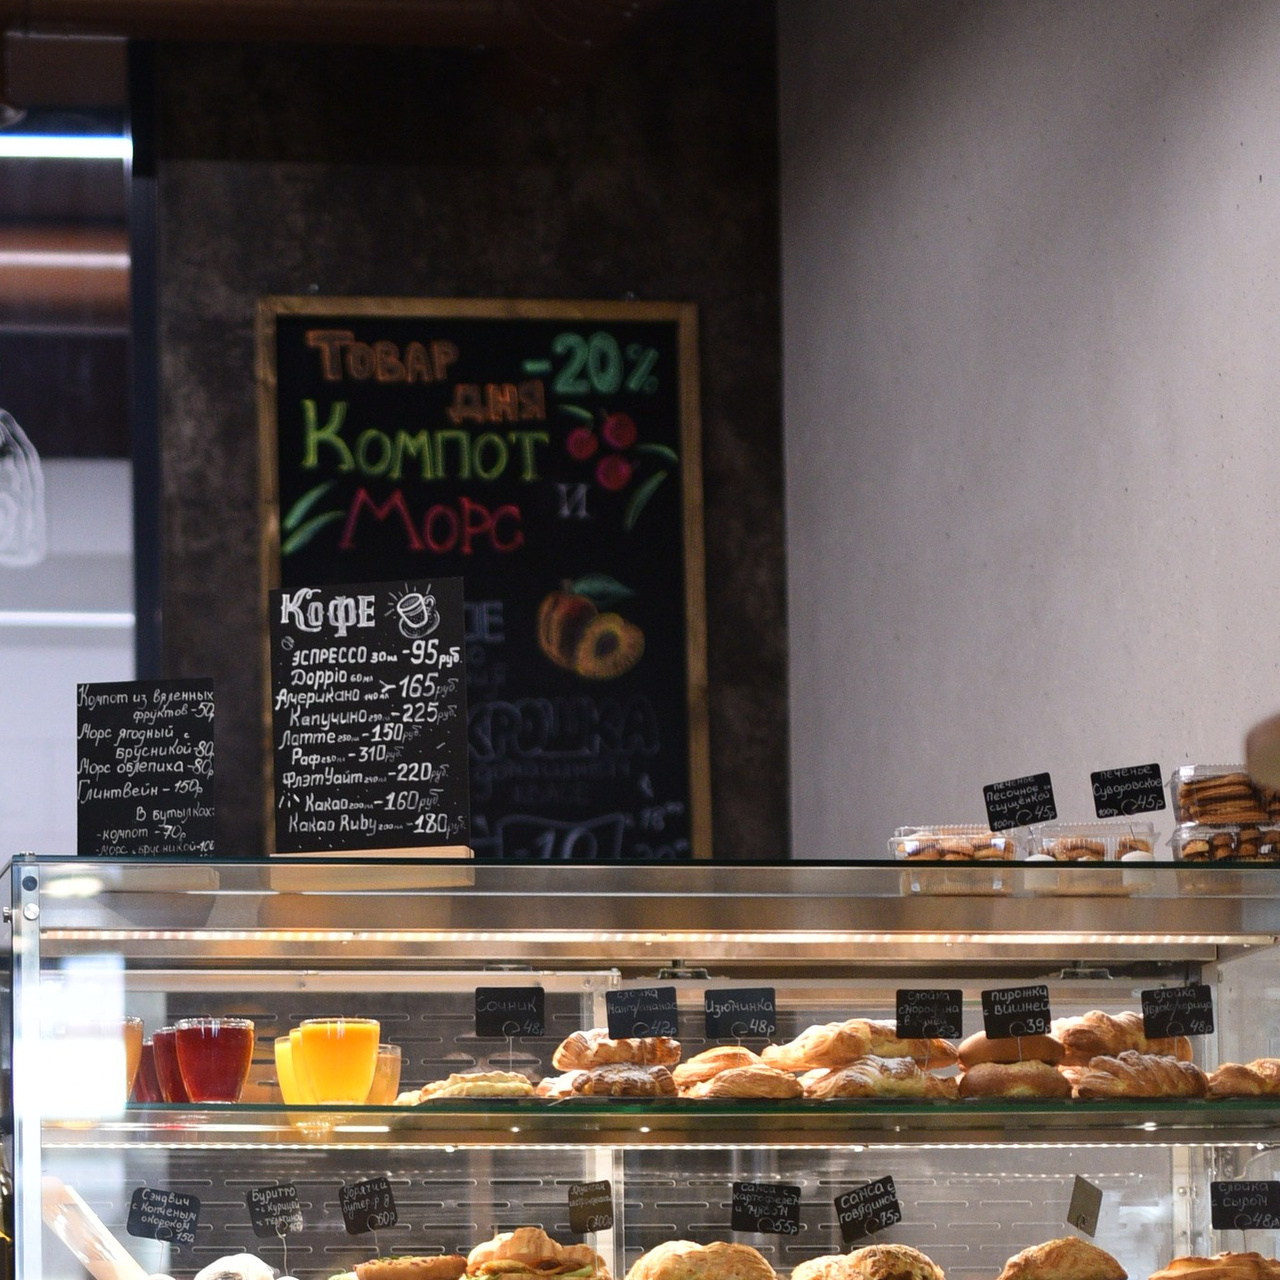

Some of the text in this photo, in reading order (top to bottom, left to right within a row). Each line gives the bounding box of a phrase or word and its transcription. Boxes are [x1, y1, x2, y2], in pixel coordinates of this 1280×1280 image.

[77, 684, 128, 711] Компот
[153, 688, 214, 708] вяленных
[275, 687, 360, 711] Американо
[133, 703, 188, 725] фруктов
[290, 704, 367, 731] Капучино
[77, 723, 112, 747] Морс
[113, 725, 173, 748] ягодный
[278, 730, 336, 750] Латте
[77, 758, 111, 782] Морс
[77, 779, 158, 804] Глинтвейн
[1093, 778, 1163, 800] Суворовское
[304, 792, 348, 812] Какао
[289, 812, 335, 833] Какао
[705, 998, 774, 1018] Изюминка
[252, 1187, 296, 1205] Буритто
